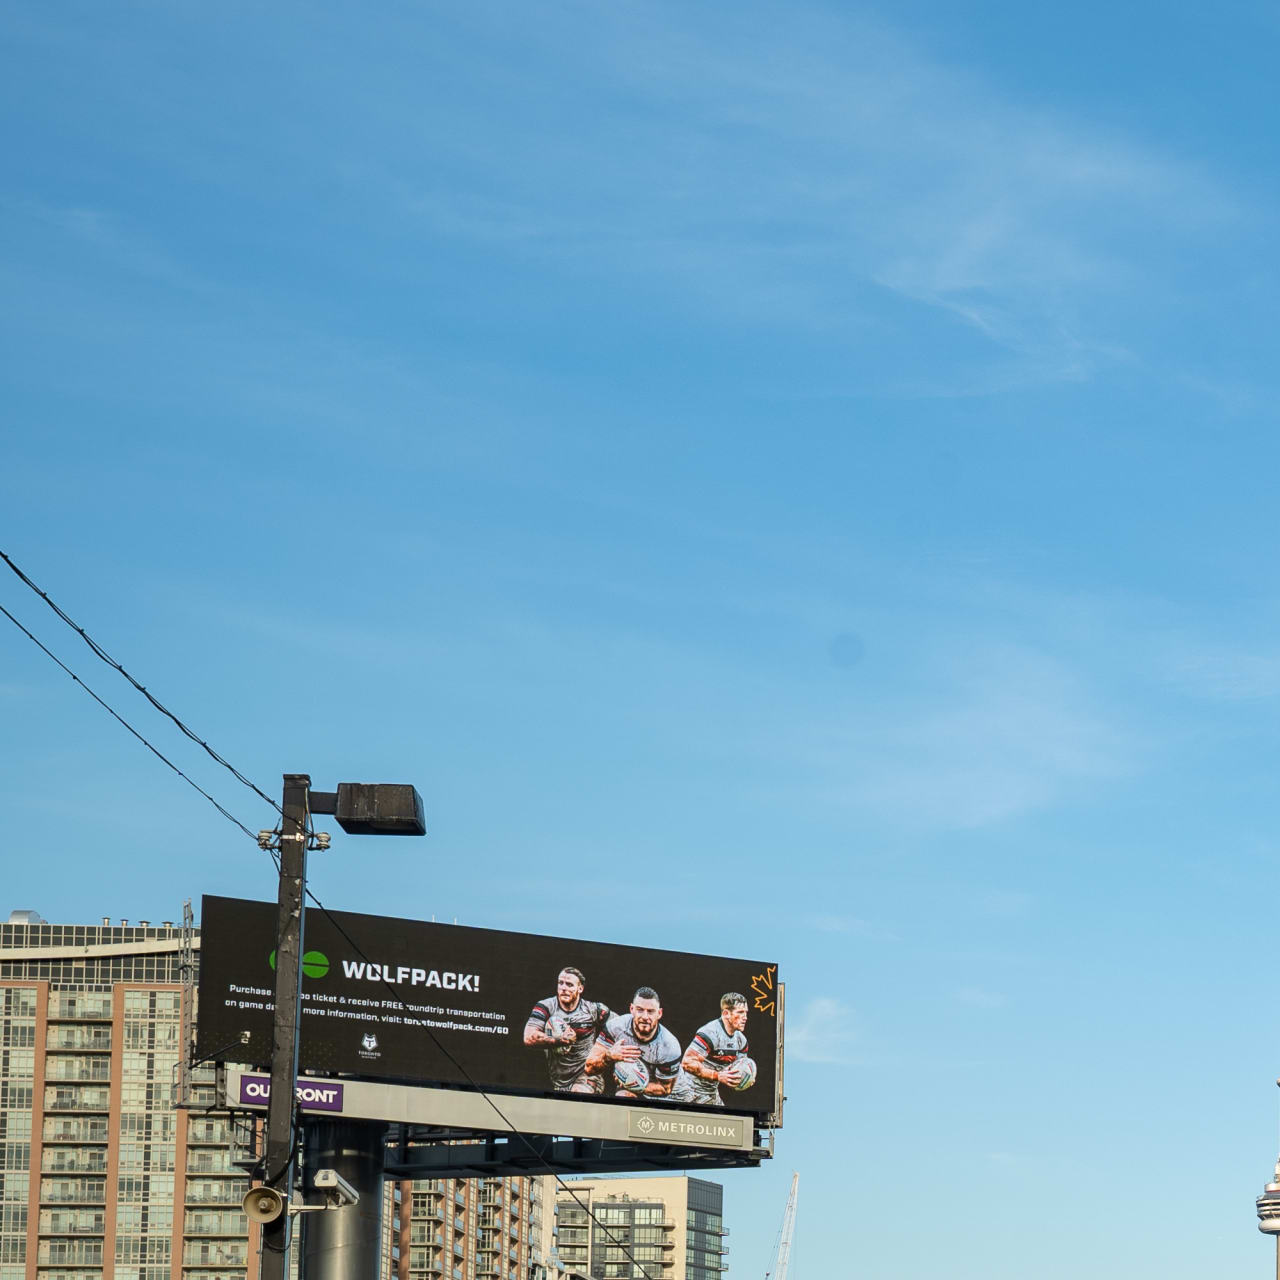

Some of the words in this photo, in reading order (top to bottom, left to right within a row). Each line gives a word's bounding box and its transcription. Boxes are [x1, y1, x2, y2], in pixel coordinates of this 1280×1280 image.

[342, 960, 480, 993] WOLFPACK!
[225, 999, 237, 1007] on
[238, 1001, 264, 1010] game
[302, 1007, 326, 1016] more
[327, 1008, 380, 1022] information,
[381, 1014, 402, 1024] visit:
[229, 984, 272, 996] Purchase
[312, 993, 338, 1003] ticket
[339, 996, 346, 1004] &
[347, 998, 380, 1008] receive
[381, 1000, 404, 1010] FREE
[446, 1007, 506, 1021] transportation
[246, 1083, 338, 1104] OURONT
[658, 1121, 736, 1138] METROLINX
